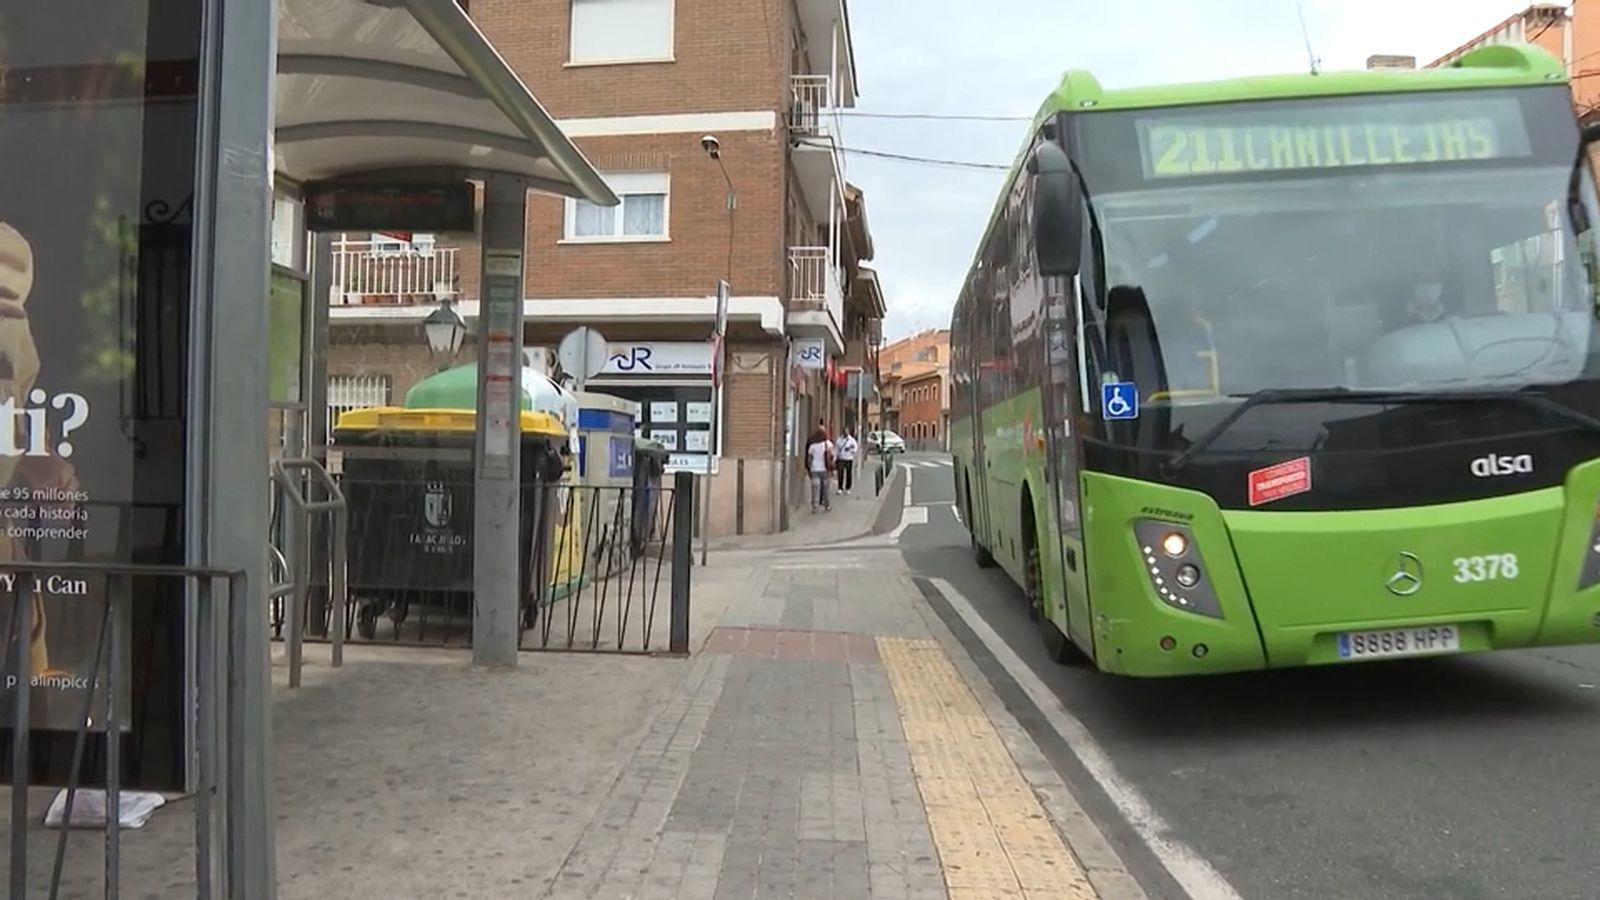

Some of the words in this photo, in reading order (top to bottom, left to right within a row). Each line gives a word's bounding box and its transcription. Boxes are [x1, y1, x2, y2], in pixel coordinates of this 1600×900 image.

[1153, 125, 1243, 174] 211
[1245, 118, 1493, 169] CANILLEJAS
[617, 346, 652, 370] JR
[1471, 453, 1534, 477] alsa
[13, 487, 29, 500] 95
[33, 486, 89, 501] millones
[4, 505, 36, 519] cada
[40, 505, 89, 521] historia
[7, 526, 89, 541] comprender
[1453, 553, 1519, 582] 3378
[47, 574, 88, 594] Can
[1354, 631, 1407, 654] 8888
[1414, 627, 1454, 650] HPP
